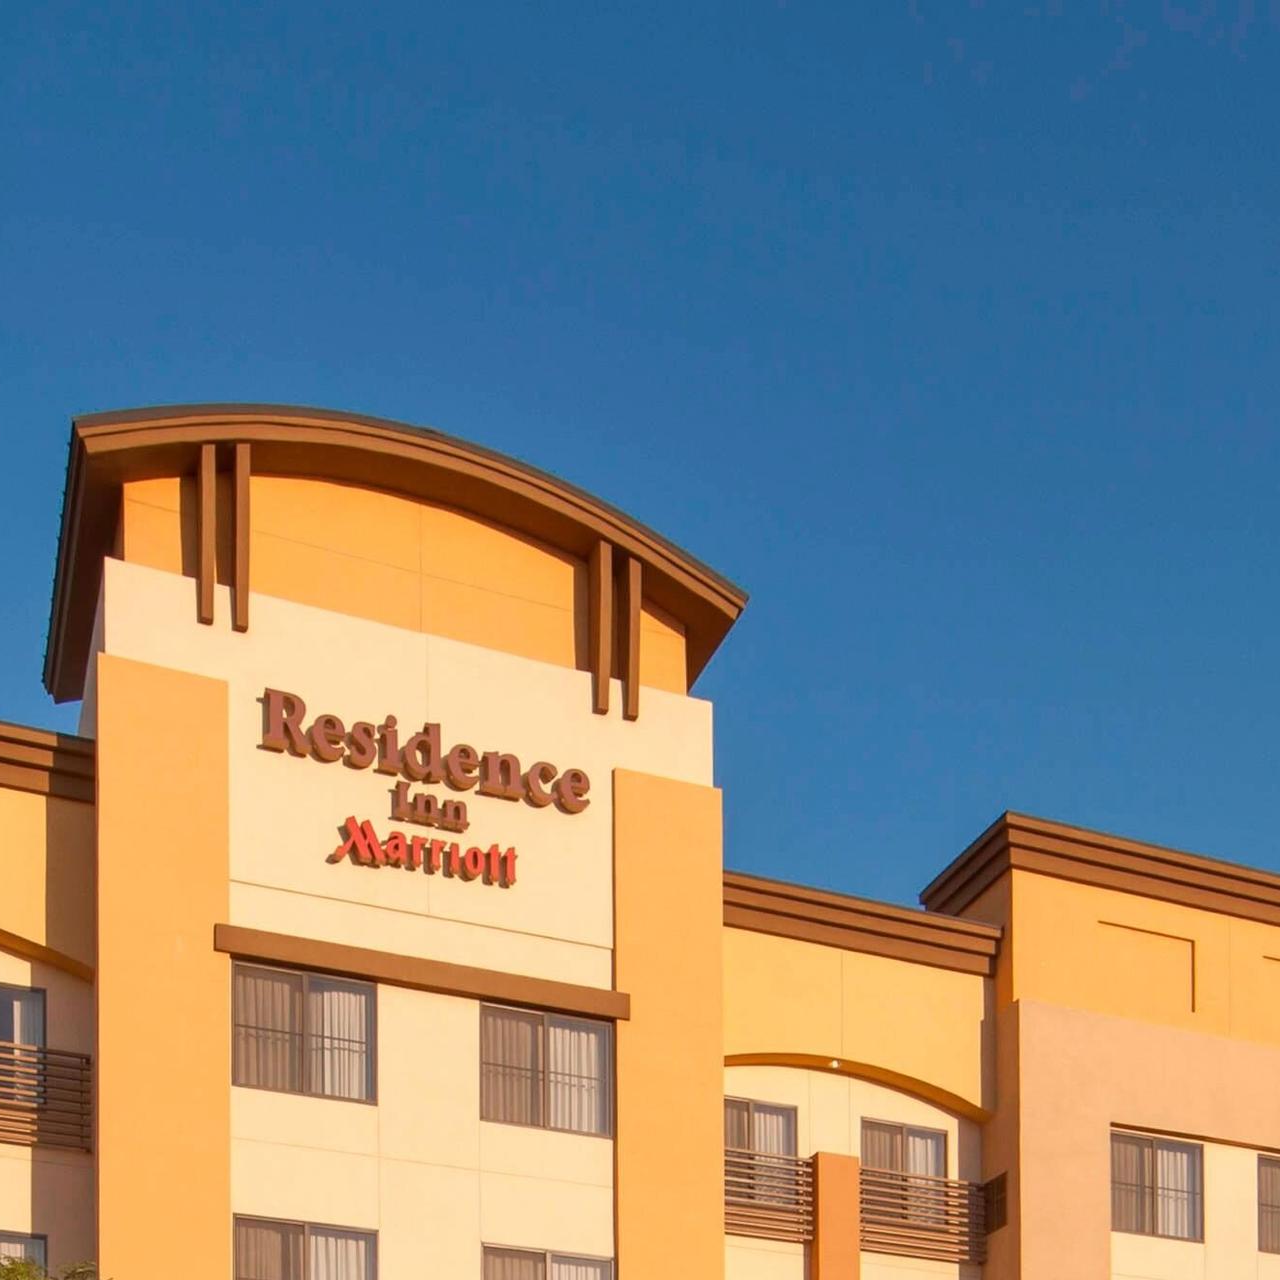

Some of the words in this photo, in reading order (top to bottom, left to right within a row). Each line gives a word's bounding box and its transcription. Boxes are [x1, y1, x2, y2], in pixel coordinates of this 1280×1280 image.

[257, 687, 590, 814] Residence
[388, 780, 469, 833] Inn
[326, 816, 518, 888] Marriott
